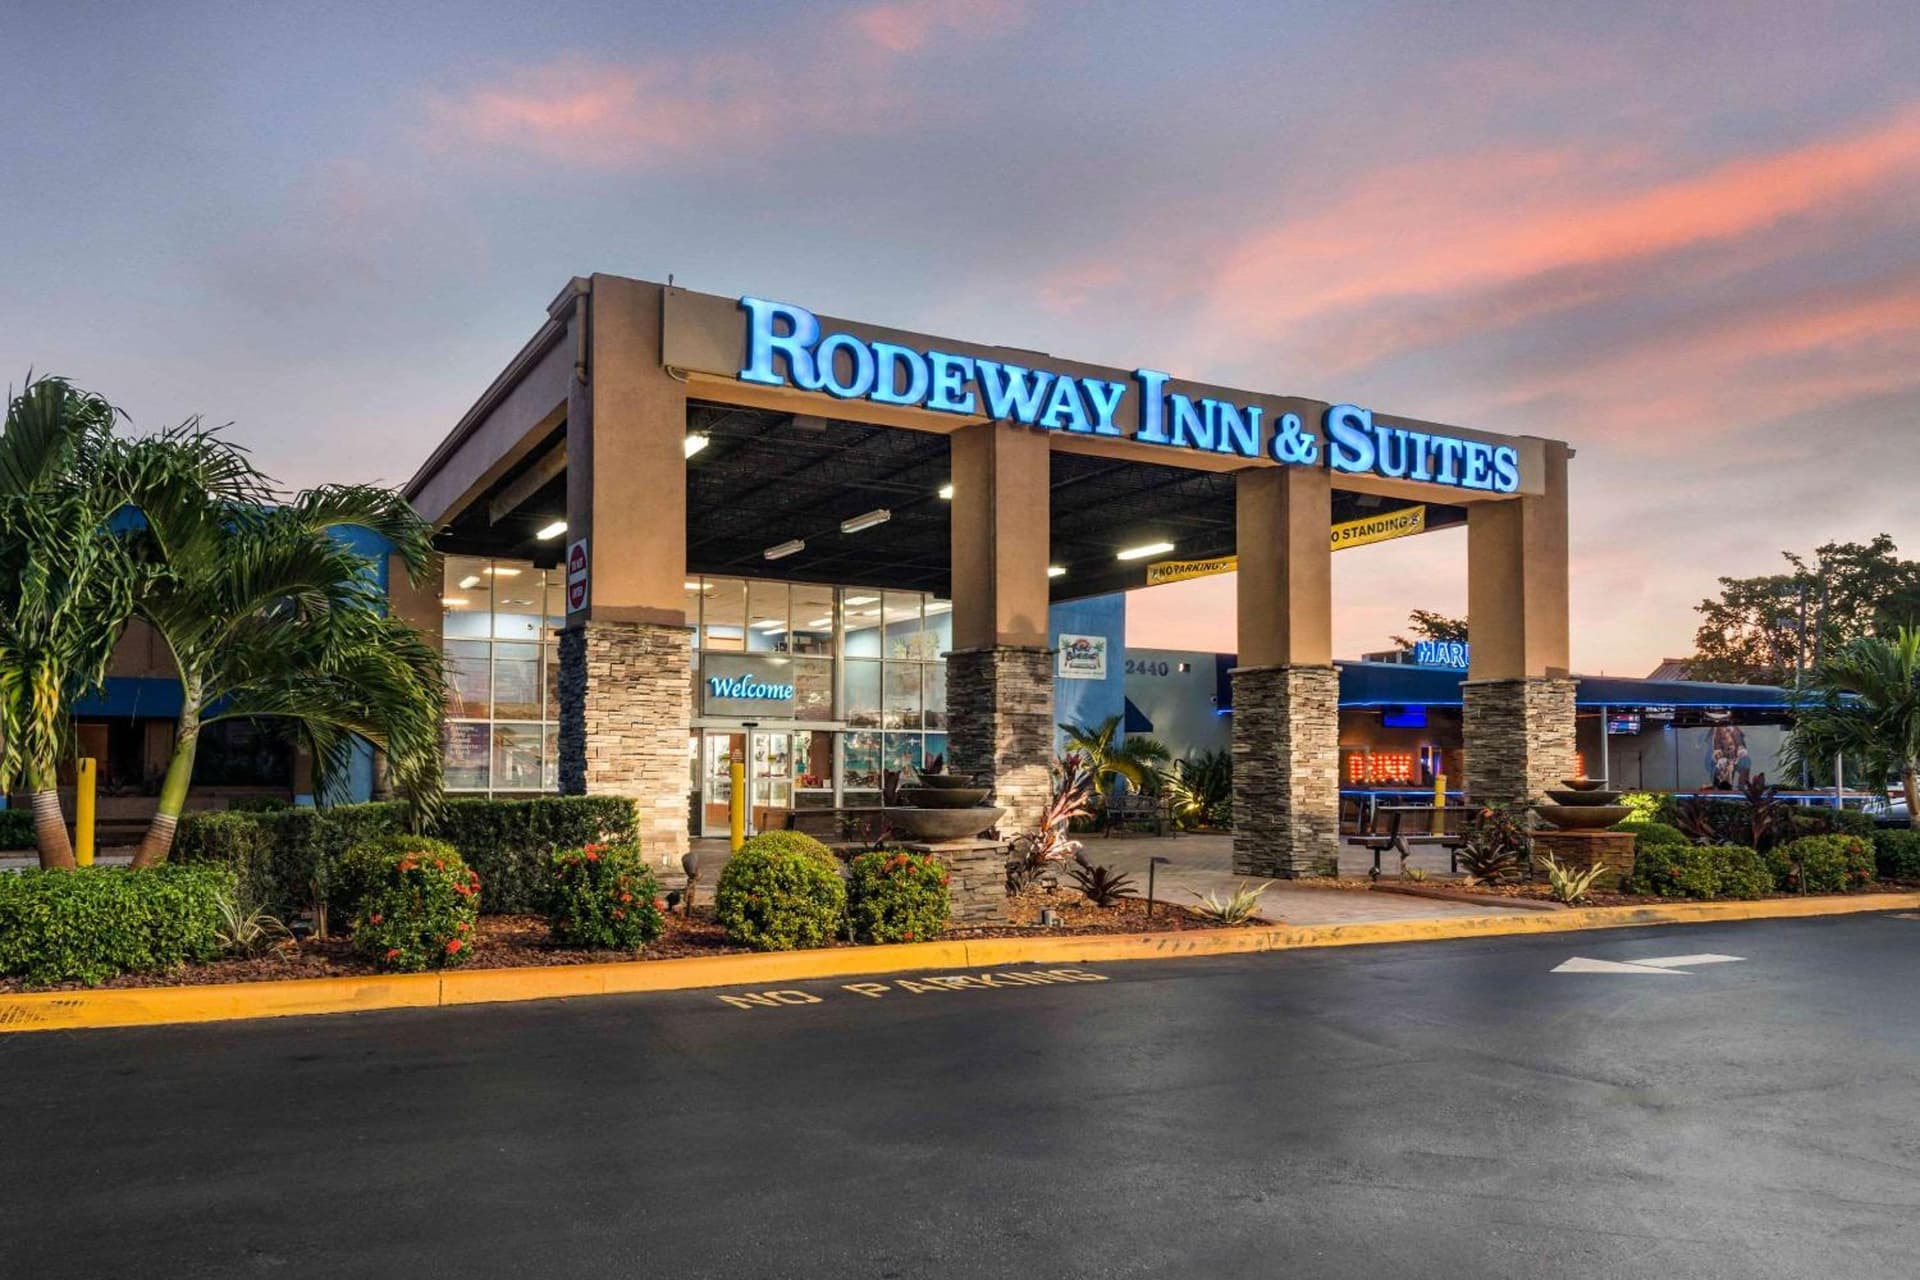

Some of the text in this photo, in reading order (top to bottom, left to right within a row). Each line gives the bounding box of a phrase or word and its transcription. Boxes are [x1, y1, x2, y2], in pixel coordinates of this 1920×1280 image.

[738, 296, 1520, 493] RODEWAY INN & SUITES
[1343, 516, 1407, 539] STANDING
[1159, 562, 1219, 577] NO PARKING
[1125, 659, 1169, 677] 2440
[710, 673, 794, 700] Welcome
[715, 968, 1110, 1010] NO PARKING
